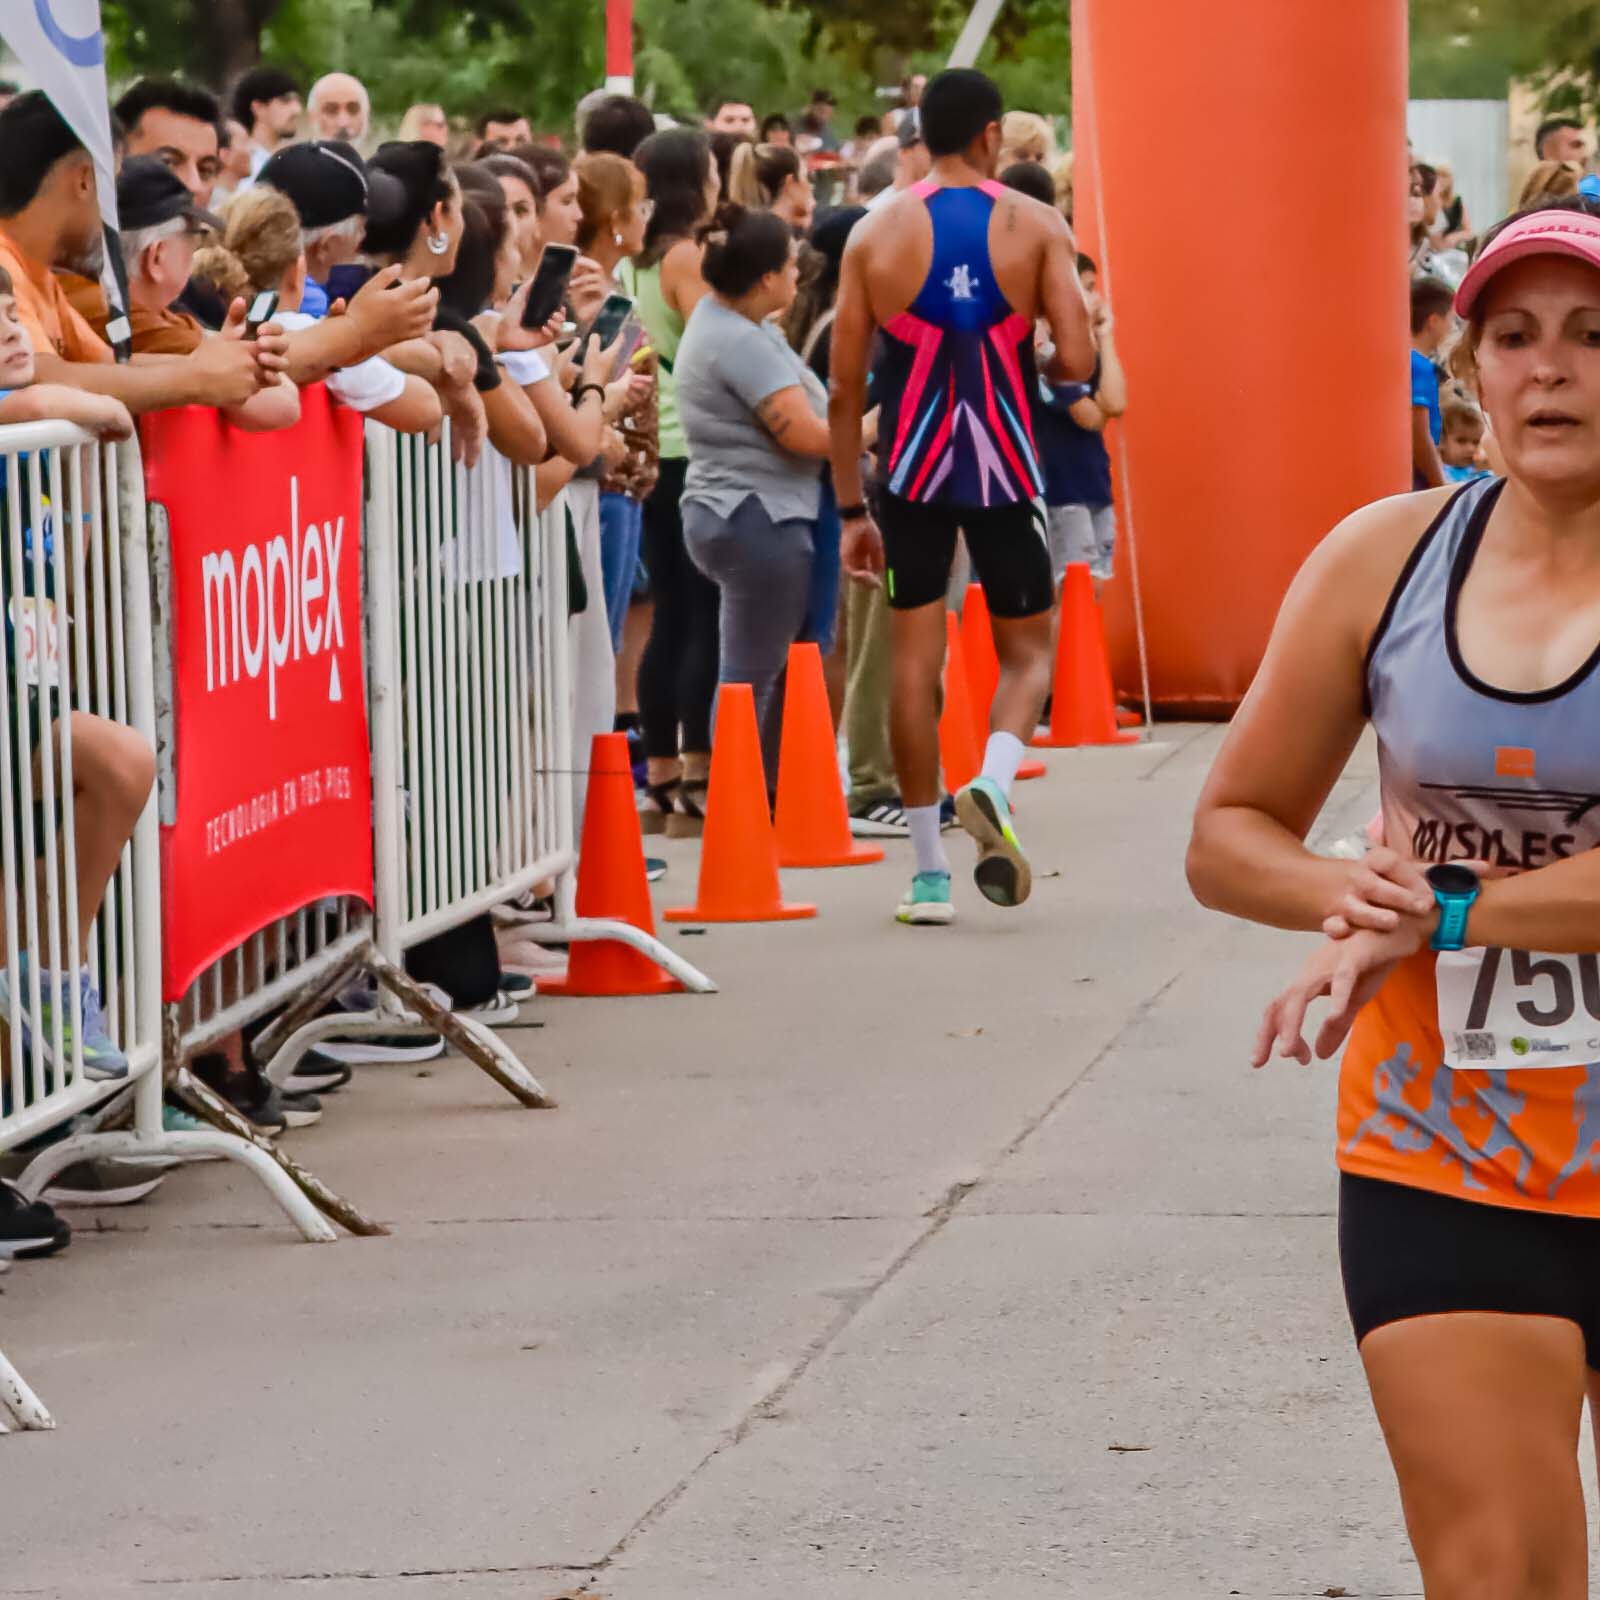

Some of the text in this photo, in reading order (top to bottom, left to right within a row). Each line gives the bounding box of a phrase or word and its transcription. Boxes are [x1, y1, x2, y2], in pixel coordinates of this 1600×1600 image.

[202, 475, 344, 720] moplex
[206, 789, 279, 856] TECNOLOGIA
[284, 780, 297, 816] EN
